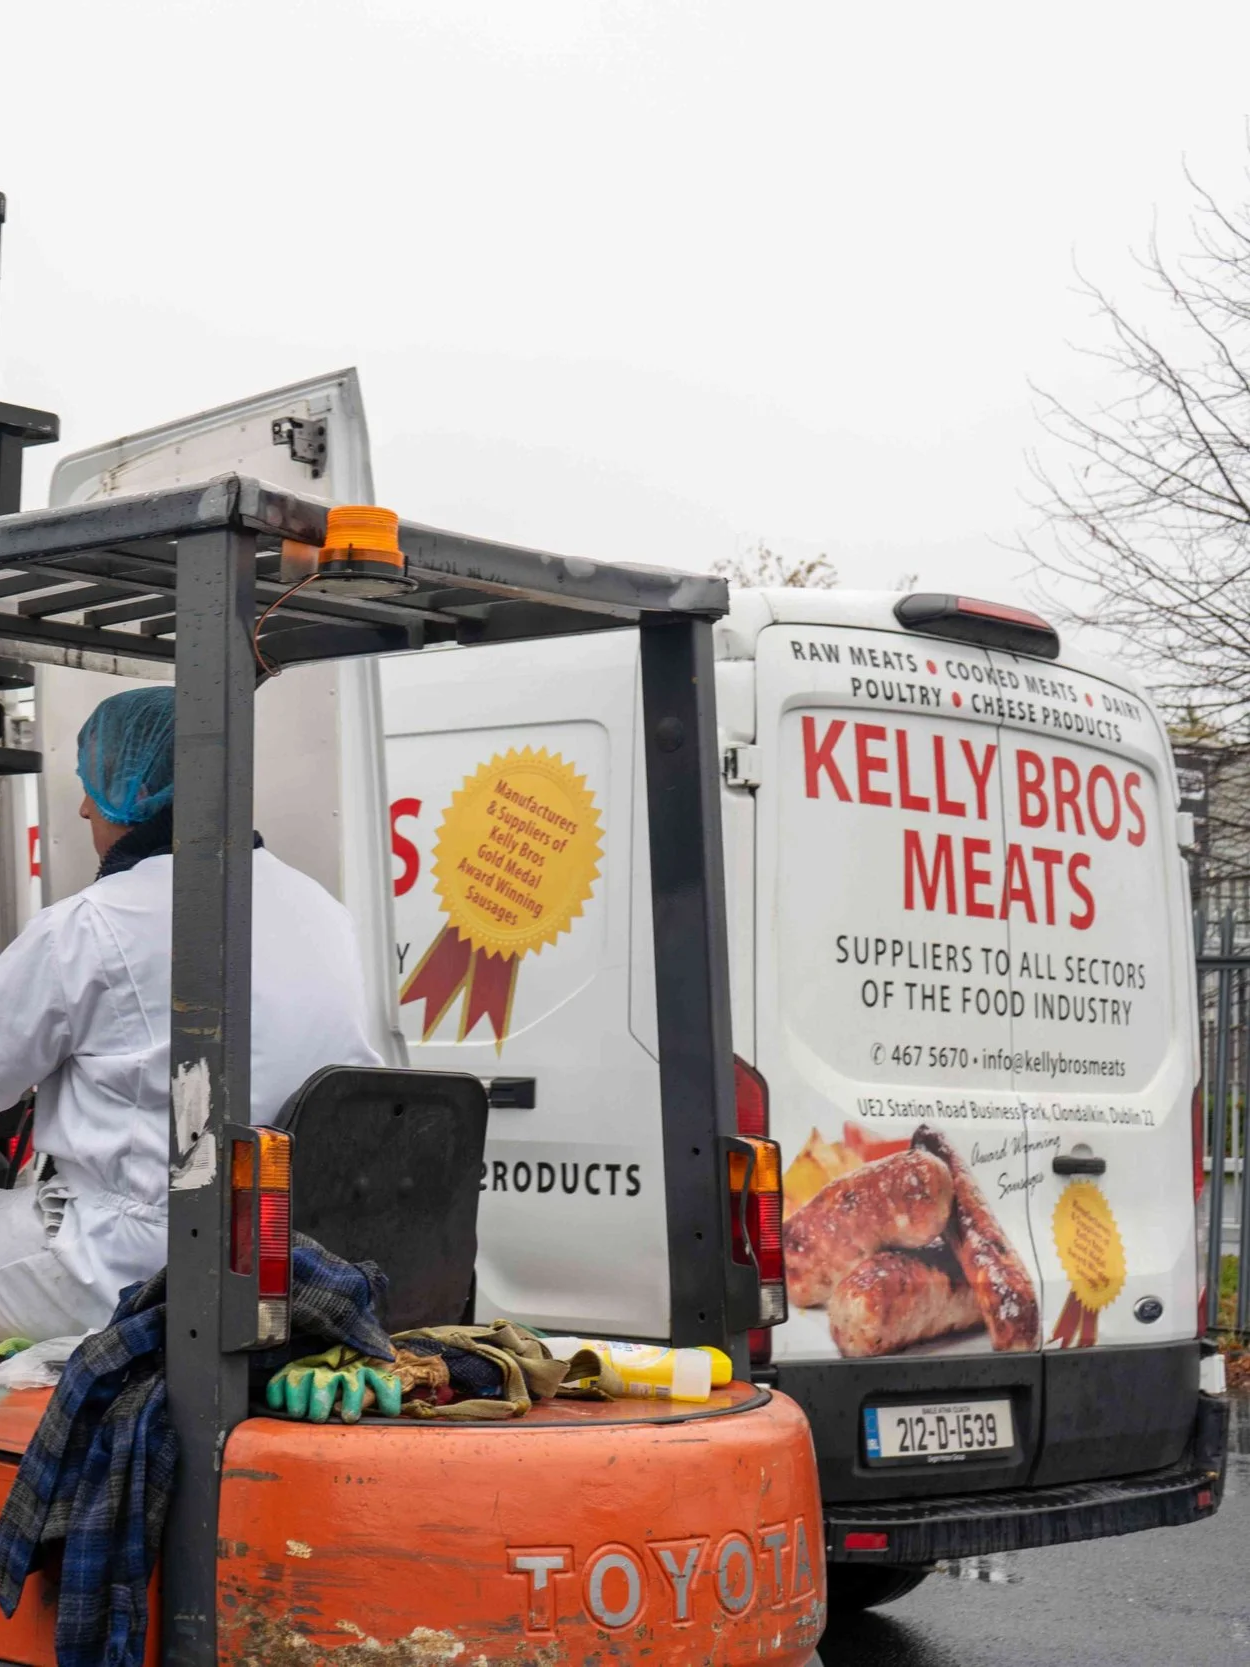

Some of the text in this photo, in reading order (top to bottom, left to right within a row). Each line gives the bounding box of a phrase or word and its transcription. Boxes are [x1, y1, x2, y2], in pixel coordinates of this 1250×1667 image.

[791, 641, 1142, 722] RAW MEATS COOKED MEATS DAIRY
[851, 677, 1122, 742] POULTRY CHEESE PRODUCTS
[494, 779, 578, 835] Manufacturers
[802, 715, 1146, 847] KELLY BROS
[486, 800, 568, 853] & Suppliers of
[488, 825, 545, 867] Kelly Bros
[457, 857, 543, 919] Award Winning
[477, 844, 542, 889] Gold Medal
[904, 829, 1095, 930] MEATS
[465, 885, 518, 926] Sausages
[836, 935, 1146, 989] SUPPLIERS TO ALL SECTORS
[862, 980, 1132, 1026] OF THE FOOD INDUSTRY
[891, 1045, 1126, 1078] 467 5670 info@kellybrosmeats
[887, 1099, 934, 1118] Station
[936, 1100, 967, 1119] Road
[969, 1101, 1020, 1120] Business
[897, 1413, 998, 1453] 212-D-1539
[507, 1516, 816, 1635] TOYOTA
